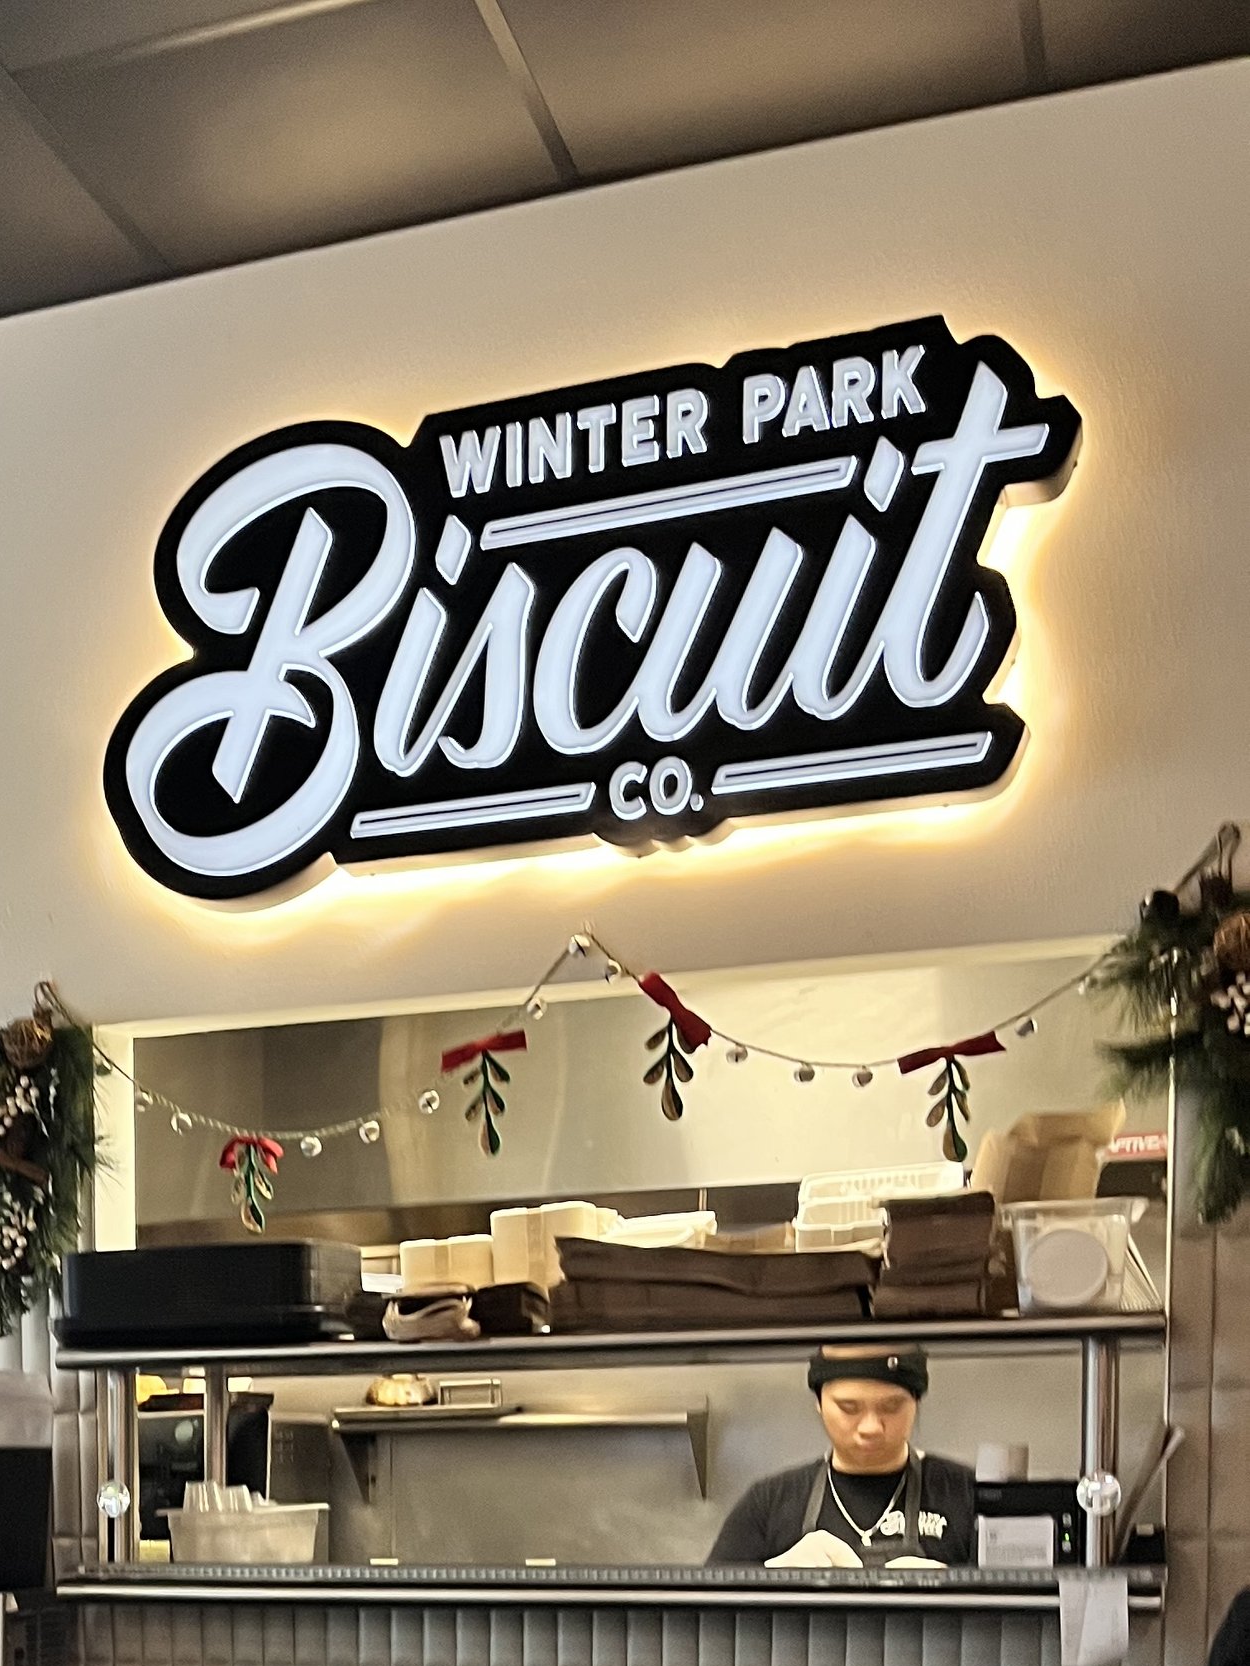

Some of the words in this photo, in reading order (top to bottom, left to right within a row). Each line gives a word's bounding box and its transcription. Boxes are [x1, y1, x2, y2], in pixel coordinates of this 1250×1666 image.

[440, 389, 707, 498] WINTER
[742, 345, 926, 444] PARK
[125, 360, 1050, 876] Biscuit
[608, 760, 703, 822] CO.
